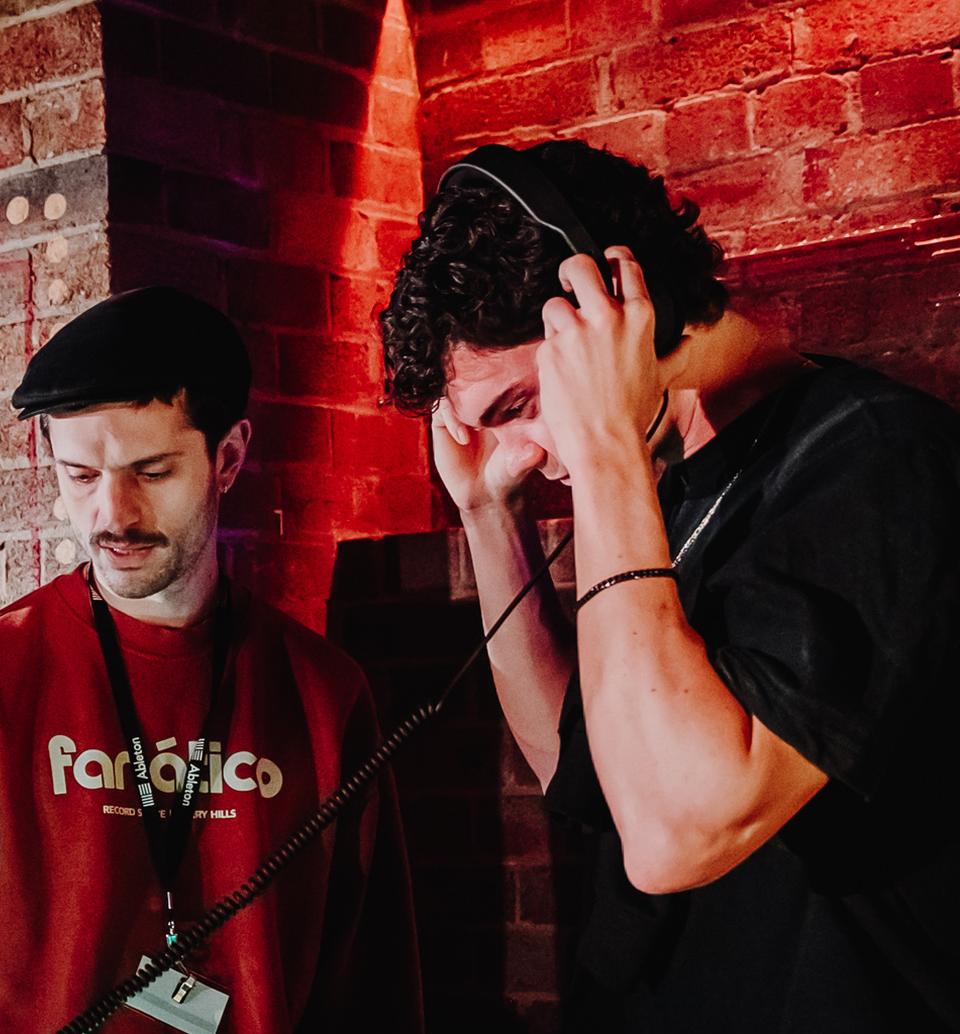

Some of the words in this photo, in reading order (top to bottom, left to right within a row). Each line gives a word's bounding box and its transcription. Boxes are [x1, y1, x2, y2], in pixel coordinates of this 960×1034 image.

[132, 736, 149, 780] Ableton
[182, 763, 201, 807] Ableton
[103, 805, 136, 817] RECORD
[210, 808, 237, 819] HILLS
